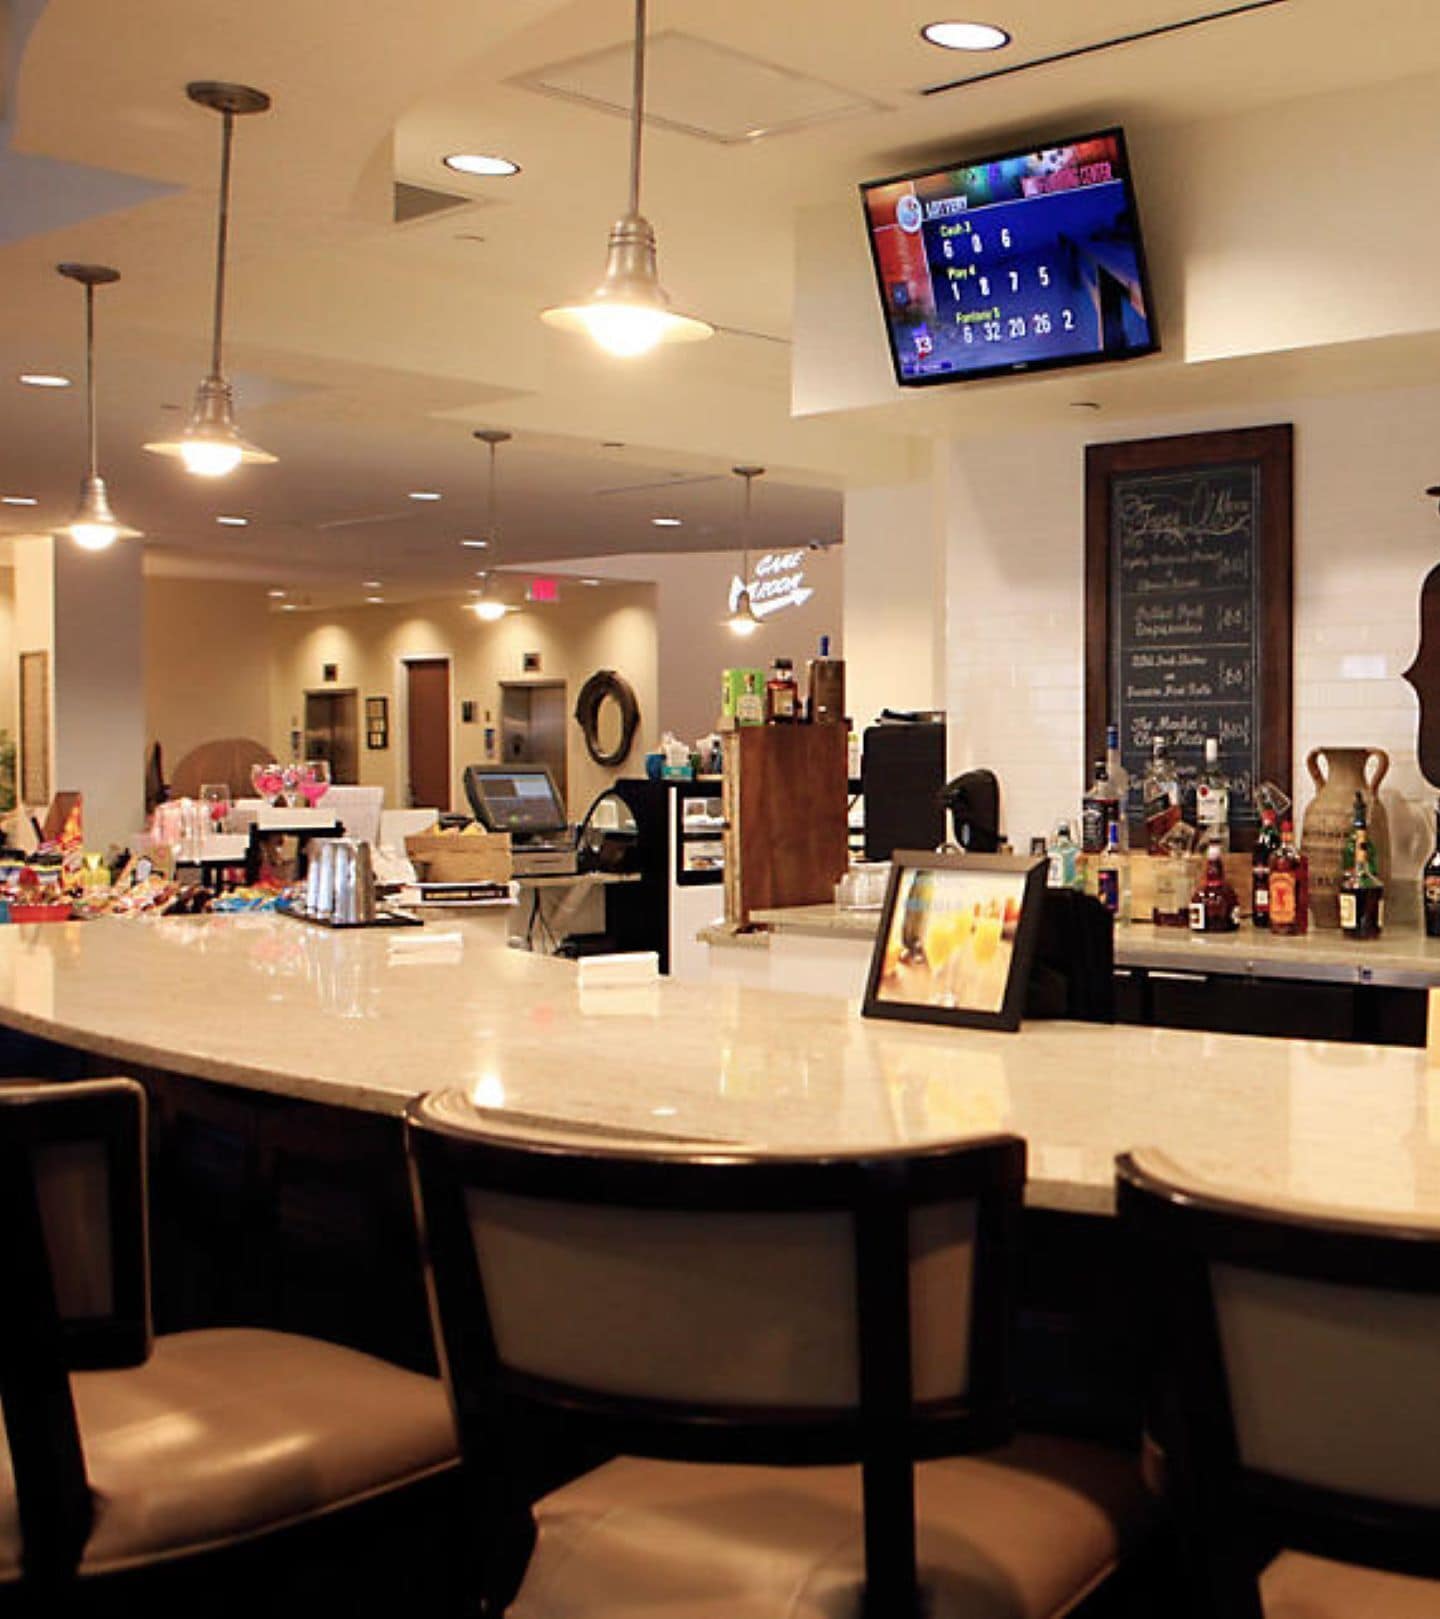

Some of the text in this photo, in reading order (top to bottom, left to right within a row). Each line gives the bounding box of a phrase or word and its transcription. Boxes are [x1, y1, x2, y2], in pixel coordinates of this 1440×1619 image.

[940, 225, 962, 239] Cash
[948, 267, 968, 282] Play
[950, 282, 961, 300] 1
[1008, 271, 1019, 292] 7
[1039, 266, 1050, 287] 5
[983, 322, 1002, 342] 32
[1009, 318, 1026, 338] 20
[1033, 314, 1052, 335] 26
[1062, 309, 1075, 330] 2
